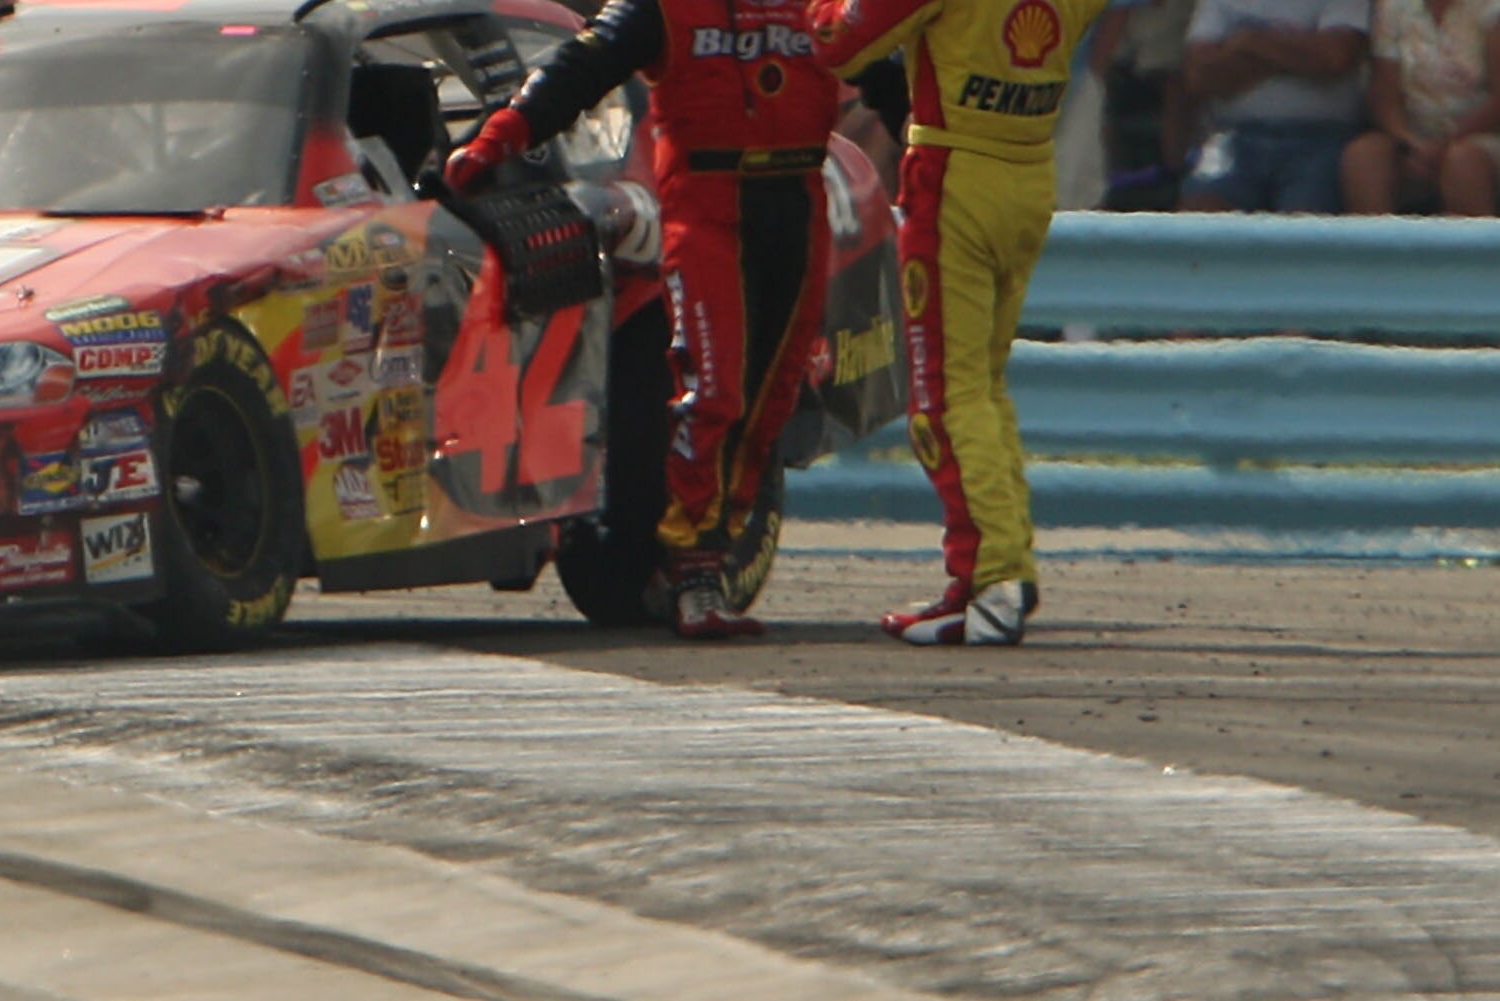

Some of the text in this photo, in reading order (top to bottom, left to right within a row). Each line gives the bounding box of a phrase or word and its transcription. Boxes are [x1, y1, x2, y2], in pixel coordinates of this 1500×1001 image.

[692, 23, 817, 61] Big Re
[60, 311, 162, 336] MOOG
[80, 347, 152, 370] COMP
[319, 406, 366, 459] 3M
[85, 516, 146, 560] WIX
